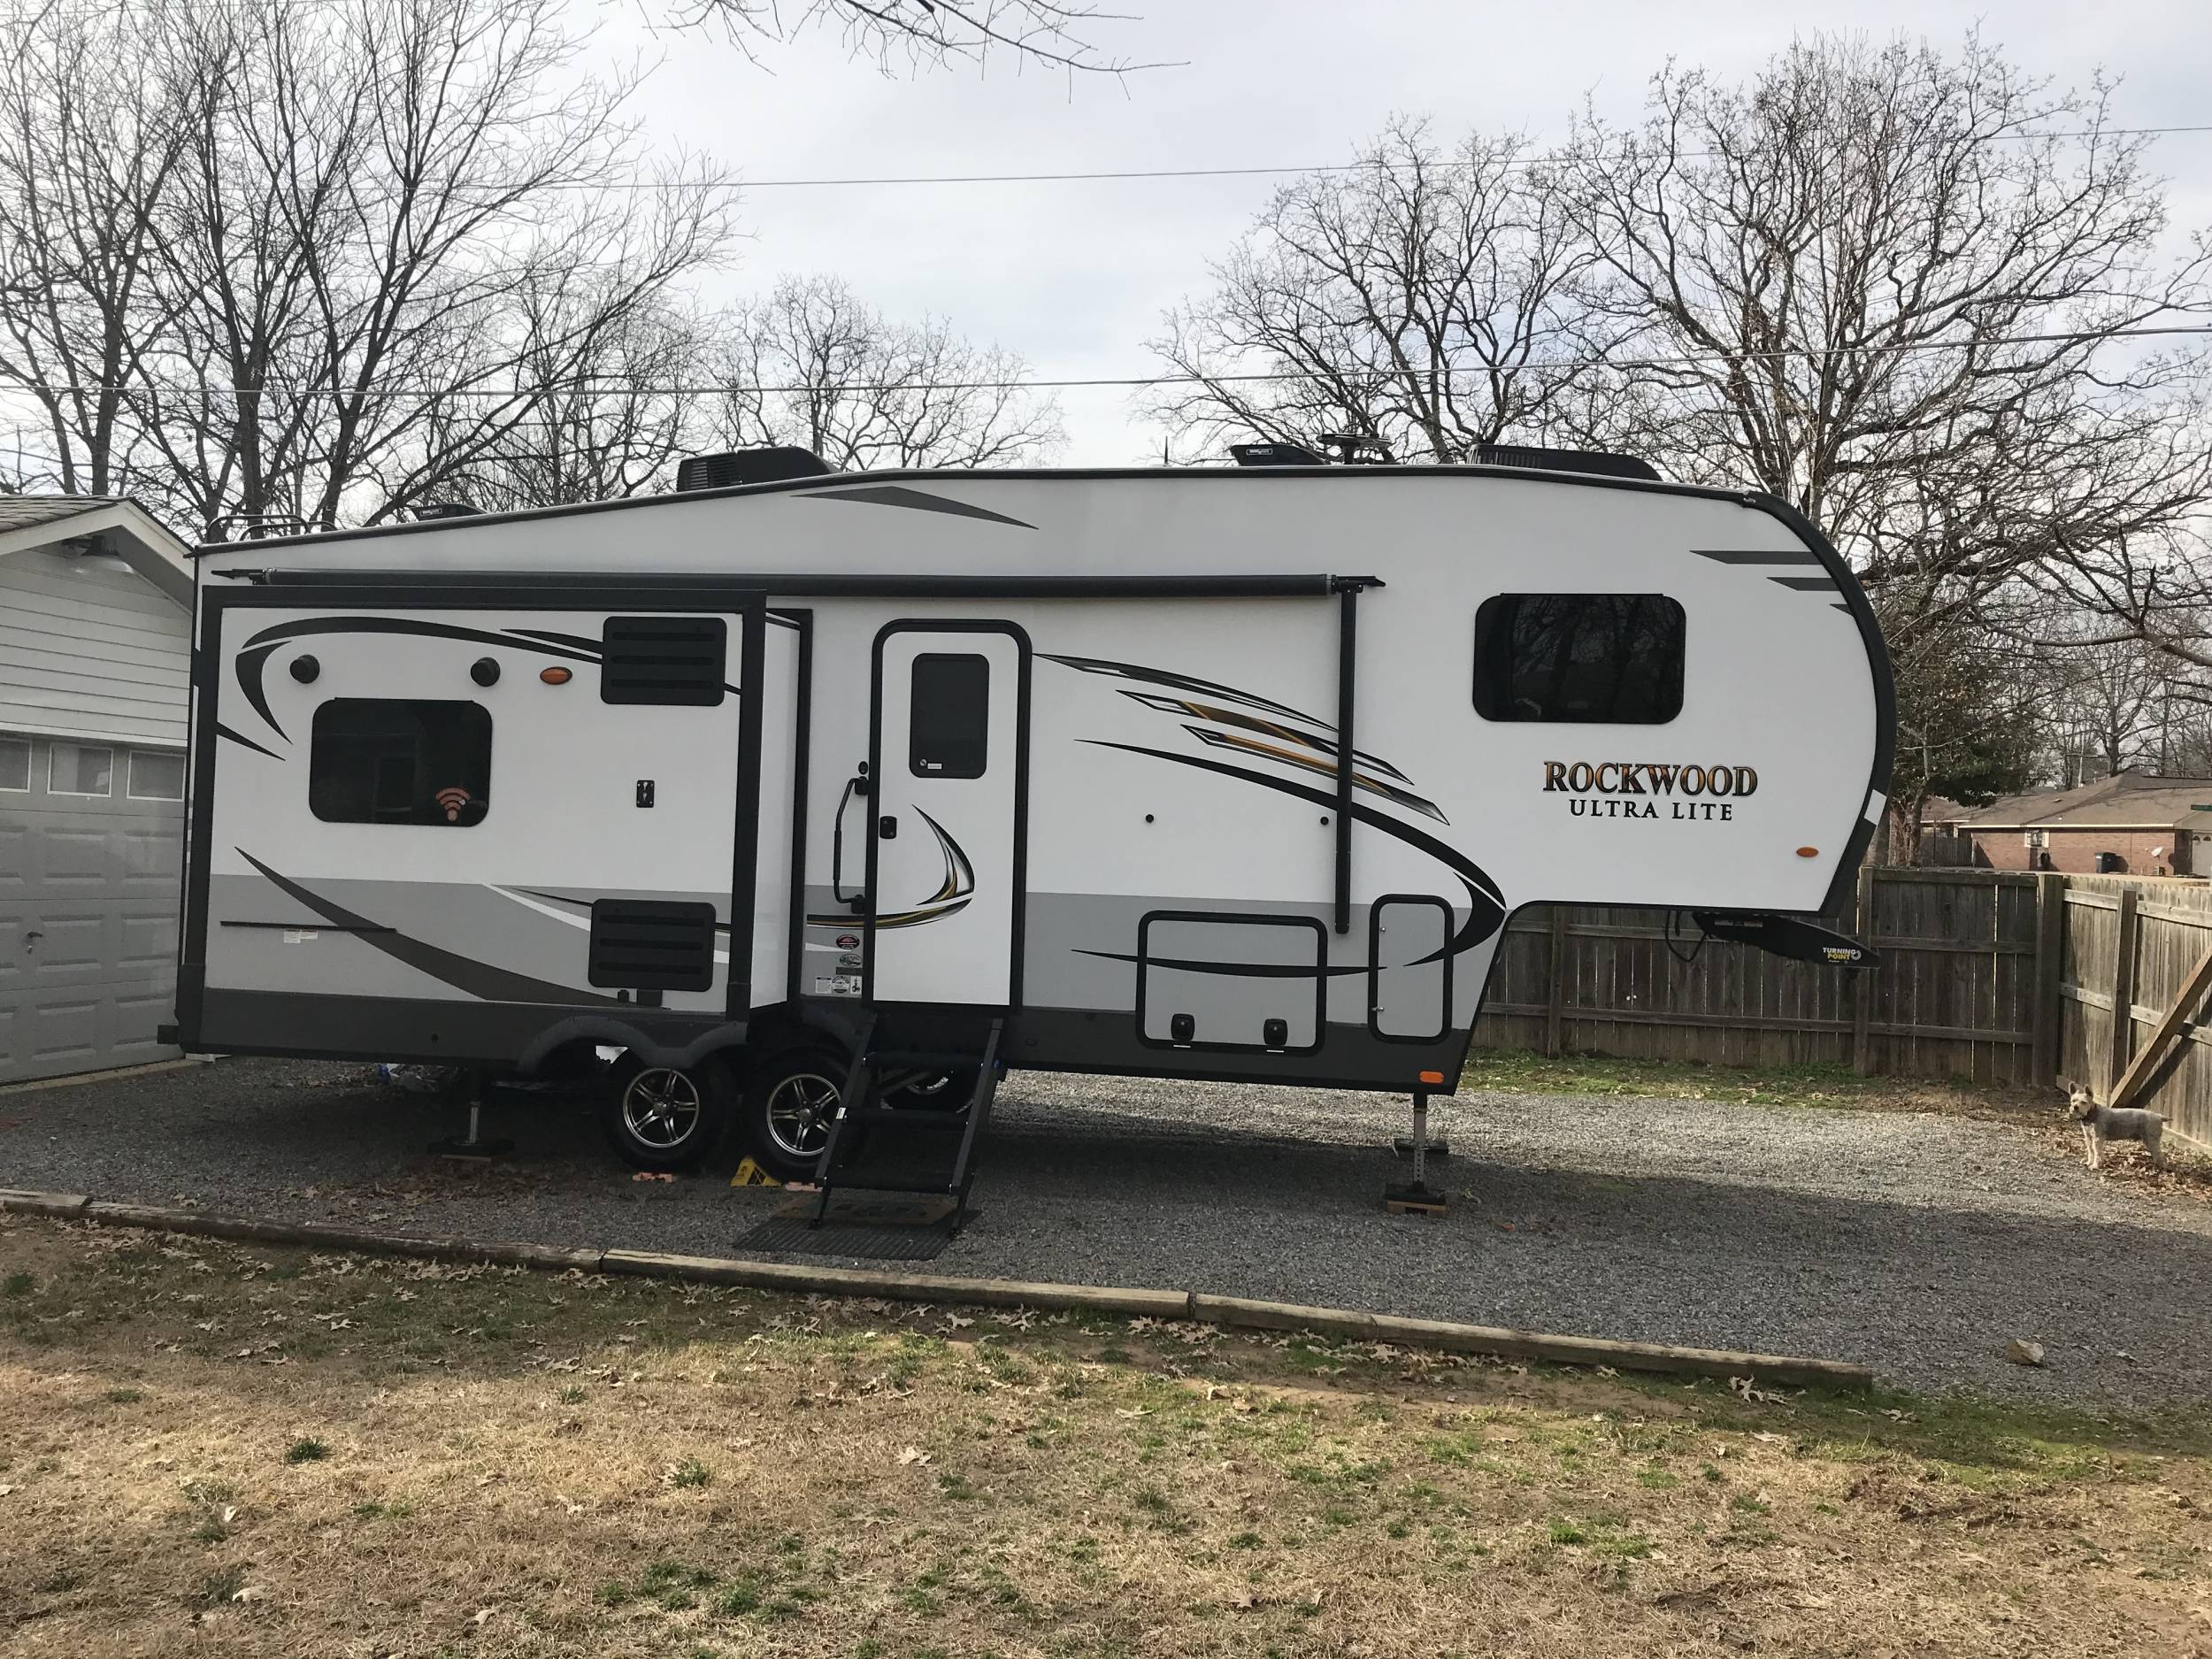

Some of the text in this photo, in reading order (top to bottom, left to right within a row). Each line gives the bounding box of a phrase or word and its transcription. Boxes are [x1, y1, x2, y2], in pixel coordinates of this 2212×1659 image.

[1542, 761, 1758, 796] ROCKWOOD
[1569, 799, 1733, 820] ULTRA LITE
